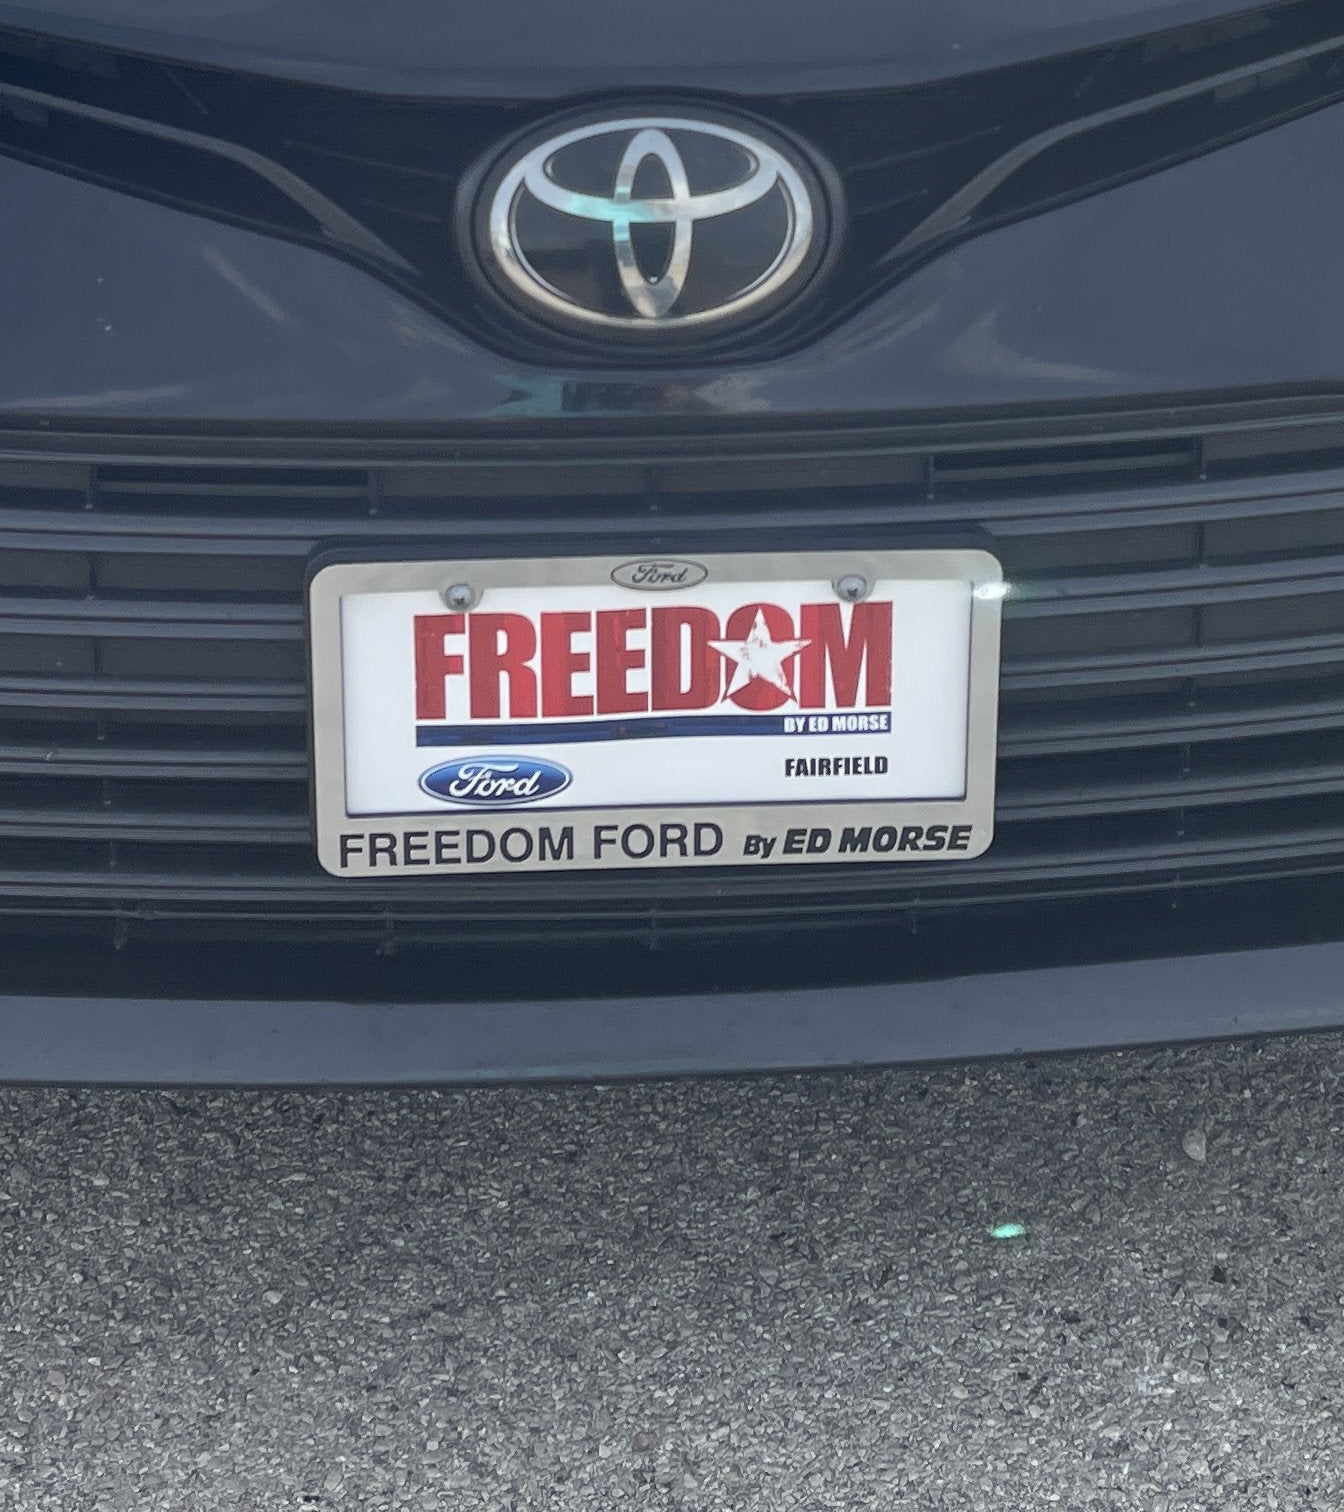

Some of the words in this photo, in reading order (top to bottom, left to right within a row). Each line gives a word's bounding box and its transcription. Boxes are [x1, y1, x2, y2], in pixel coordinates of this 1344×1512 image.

[631, 563, 689, 584] Ford
[413, 601, 894, 720] FREEDOM
[783, 717, 806, 733] BY
[808, 716, 829, 732] ED
[832, 714, 889, 731] MORSE
[448, 762, 541, 798] Ford
[784, 756, 889, 776] FAIRFIELD
[339, 826, 574, 869] FREEDOM
[593, 822, 724, 860] FORD
[743, 834, 777, 859] By
[783, 828, 832, 855] ED
[838, 824, 974, 854] MORSE
